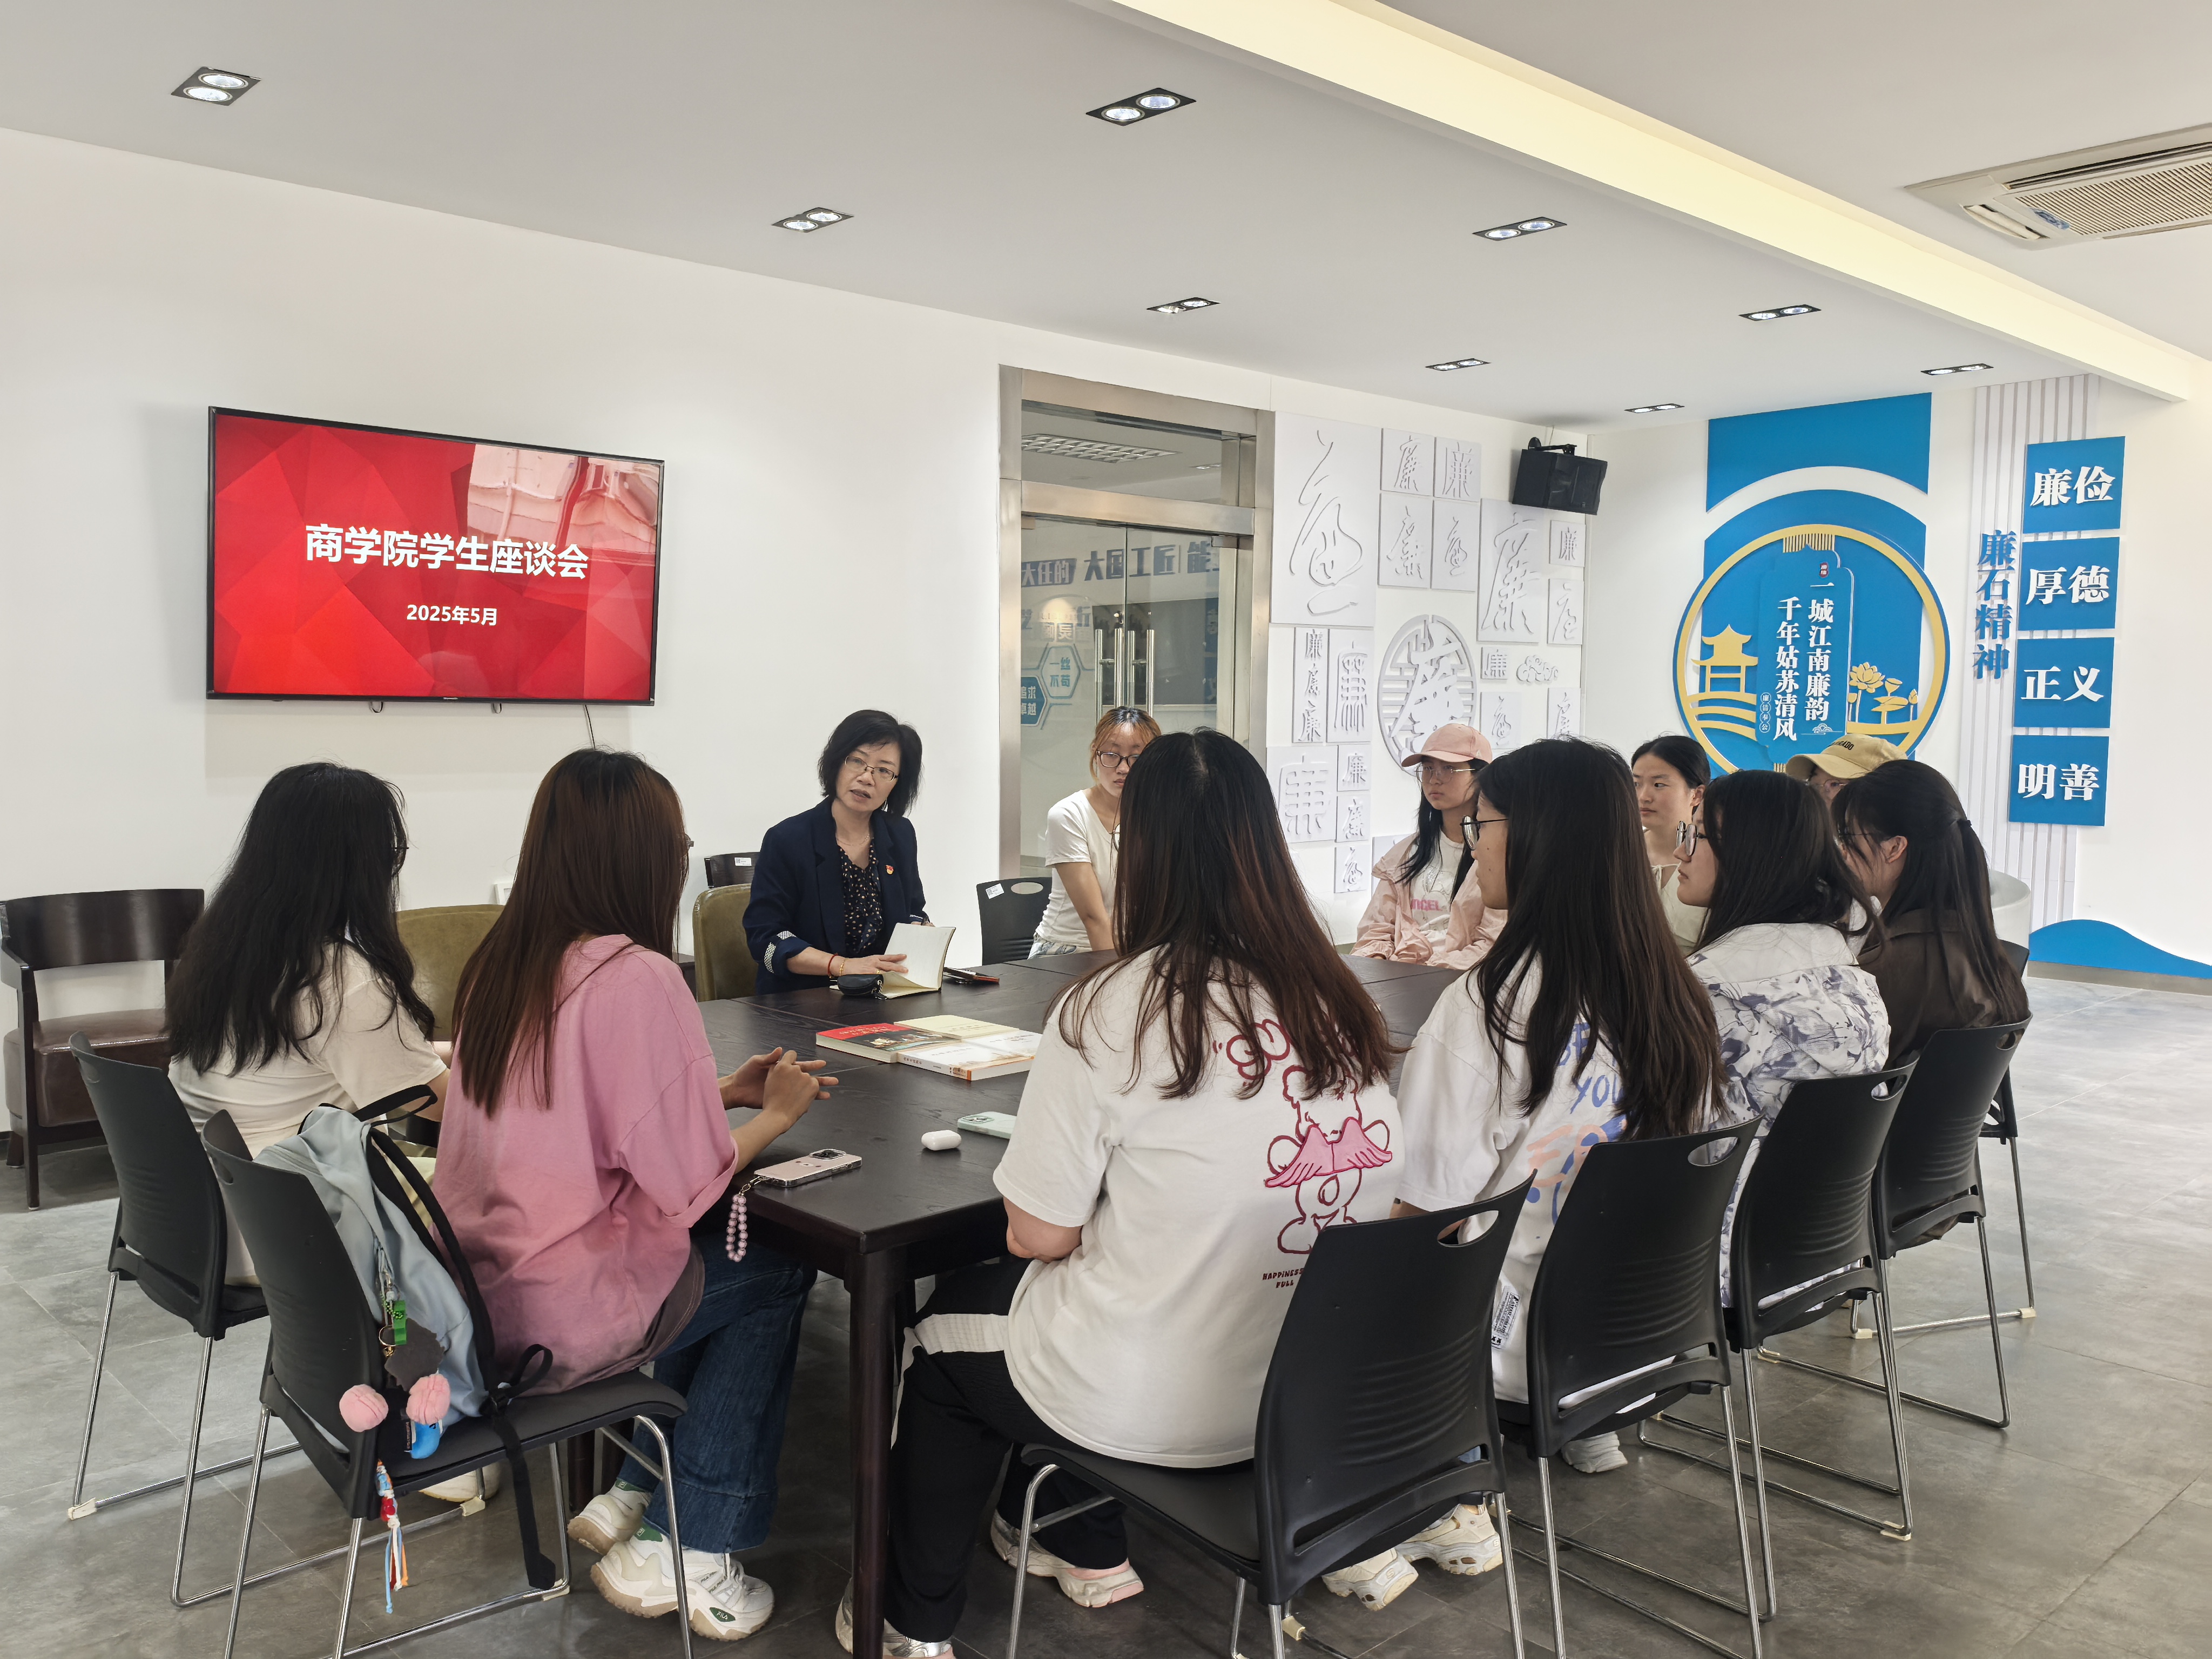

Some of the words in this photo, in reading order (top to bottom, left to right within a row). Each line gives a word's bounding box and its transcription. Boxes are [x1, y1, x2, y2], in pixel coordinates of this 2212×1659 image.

[2030, 466, 2115, 506] 廉俭
[306, 523, 589, 580] 商学院学生座谈会
[1972, 530, 2017, 679] 廉石精神
[2026, 565, 2110, 605] 厚德
[406, 604, 498, 626] 2025年5月
[1773, 596, 1802, 741] 千年姑苏清风
[1805, 582, 1835, 721] 一城江南廉韵
[2021, 666, 2104, 702] 正义
[2017, 763, 2100, 801] 明善
[1262, 1268, 1305, 1280] HAPPINESS
[1276, 1280, 1294, 1288] FULL
